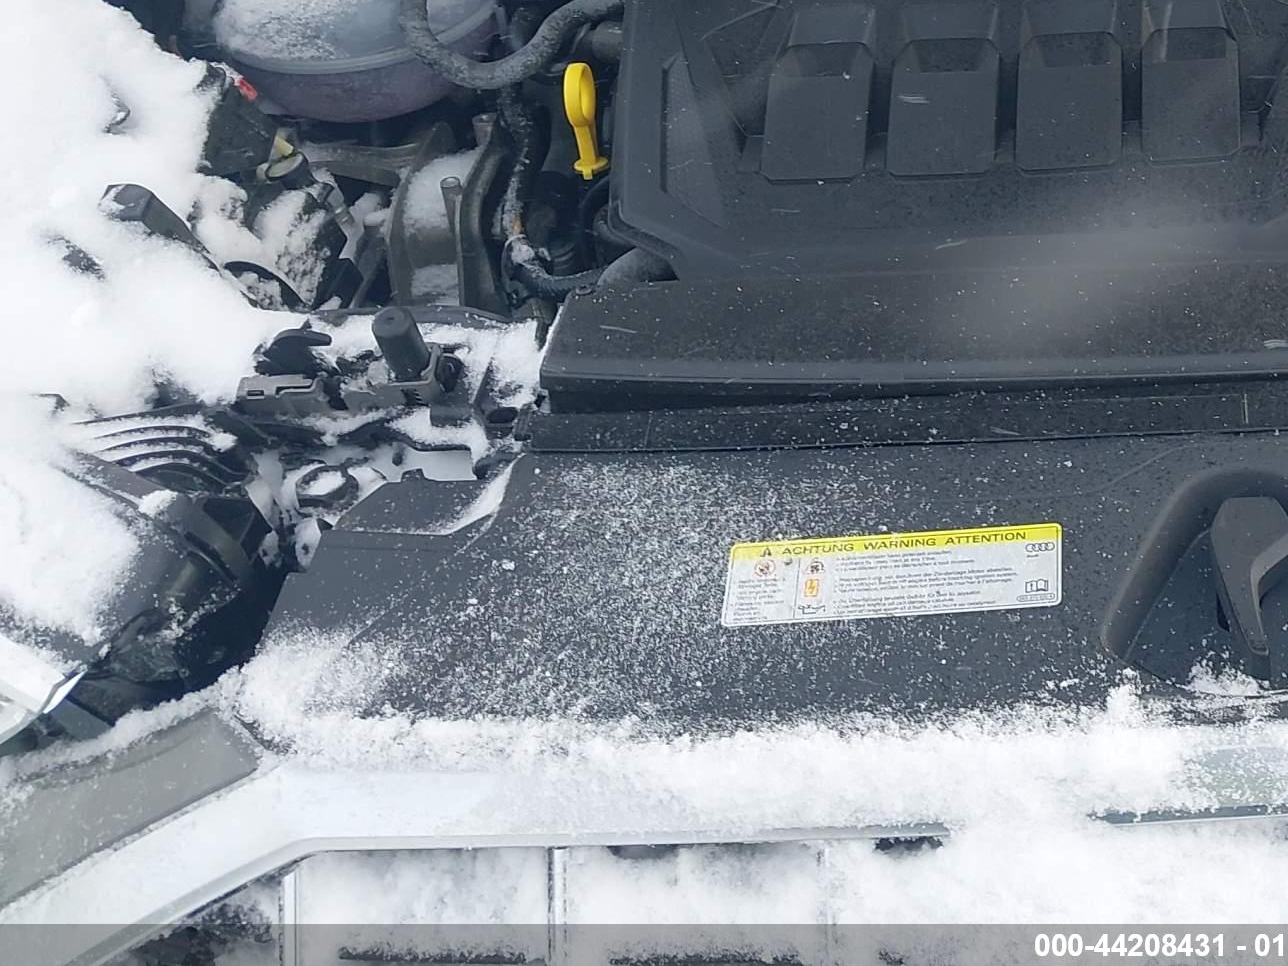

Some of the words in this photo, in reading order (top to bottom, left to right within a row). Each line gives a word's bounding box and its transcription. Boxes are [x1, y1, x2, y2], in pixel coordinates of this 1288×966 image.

[783, 543, 854, 555] ACHTUNG
[863, 538, 936, 551] WARNING
[945, 532, 1026, 545] ATTENTION
